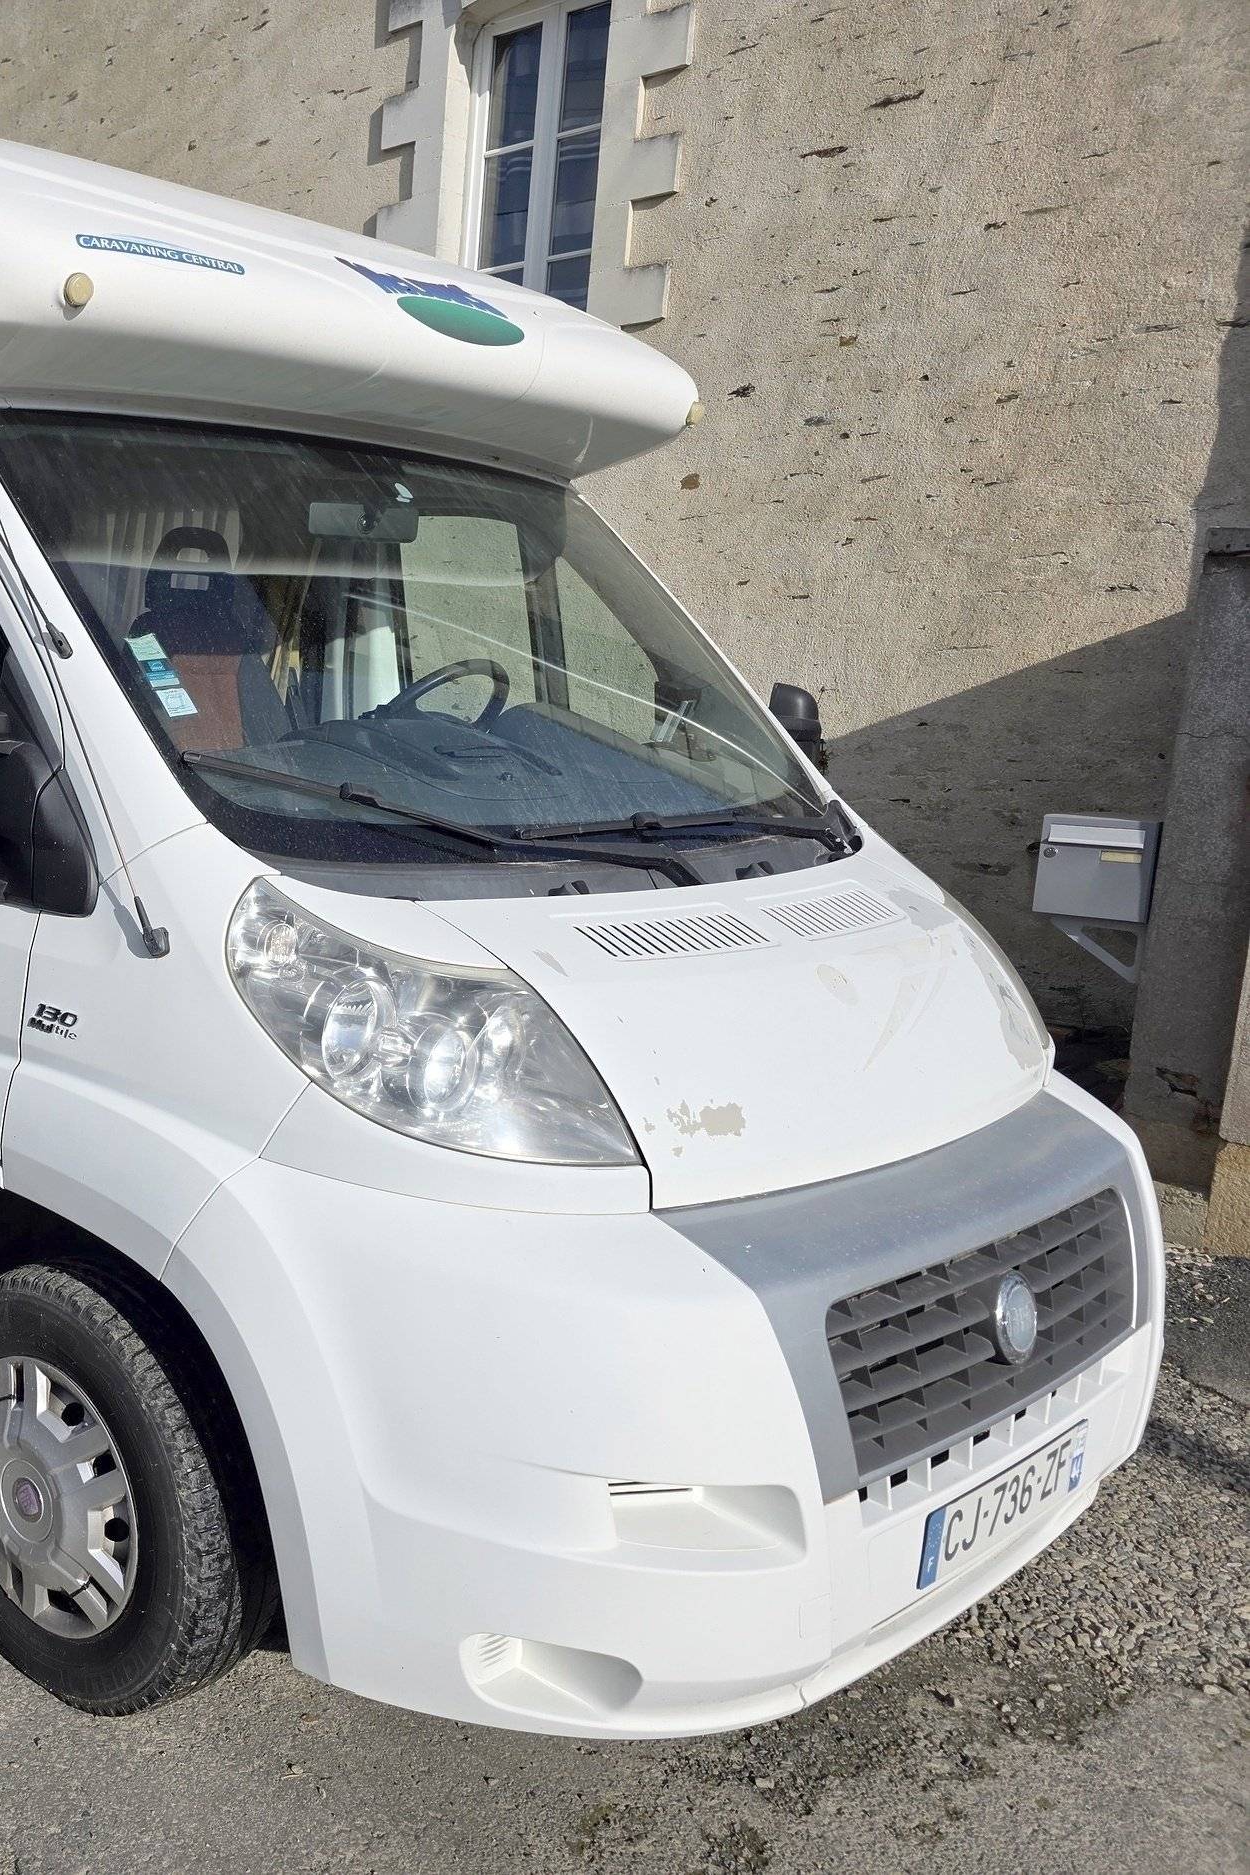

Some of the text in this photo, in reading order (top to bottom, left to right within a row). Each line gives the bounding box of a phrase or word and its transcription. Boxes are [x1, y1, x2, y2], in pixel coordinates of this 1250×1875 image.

[79, 236, 243, 274] CARAVANING CENTRAL
[35, 1003, 78, 1028] 130
[944, 1438, 1072, 1562] CJ-736-ZF
